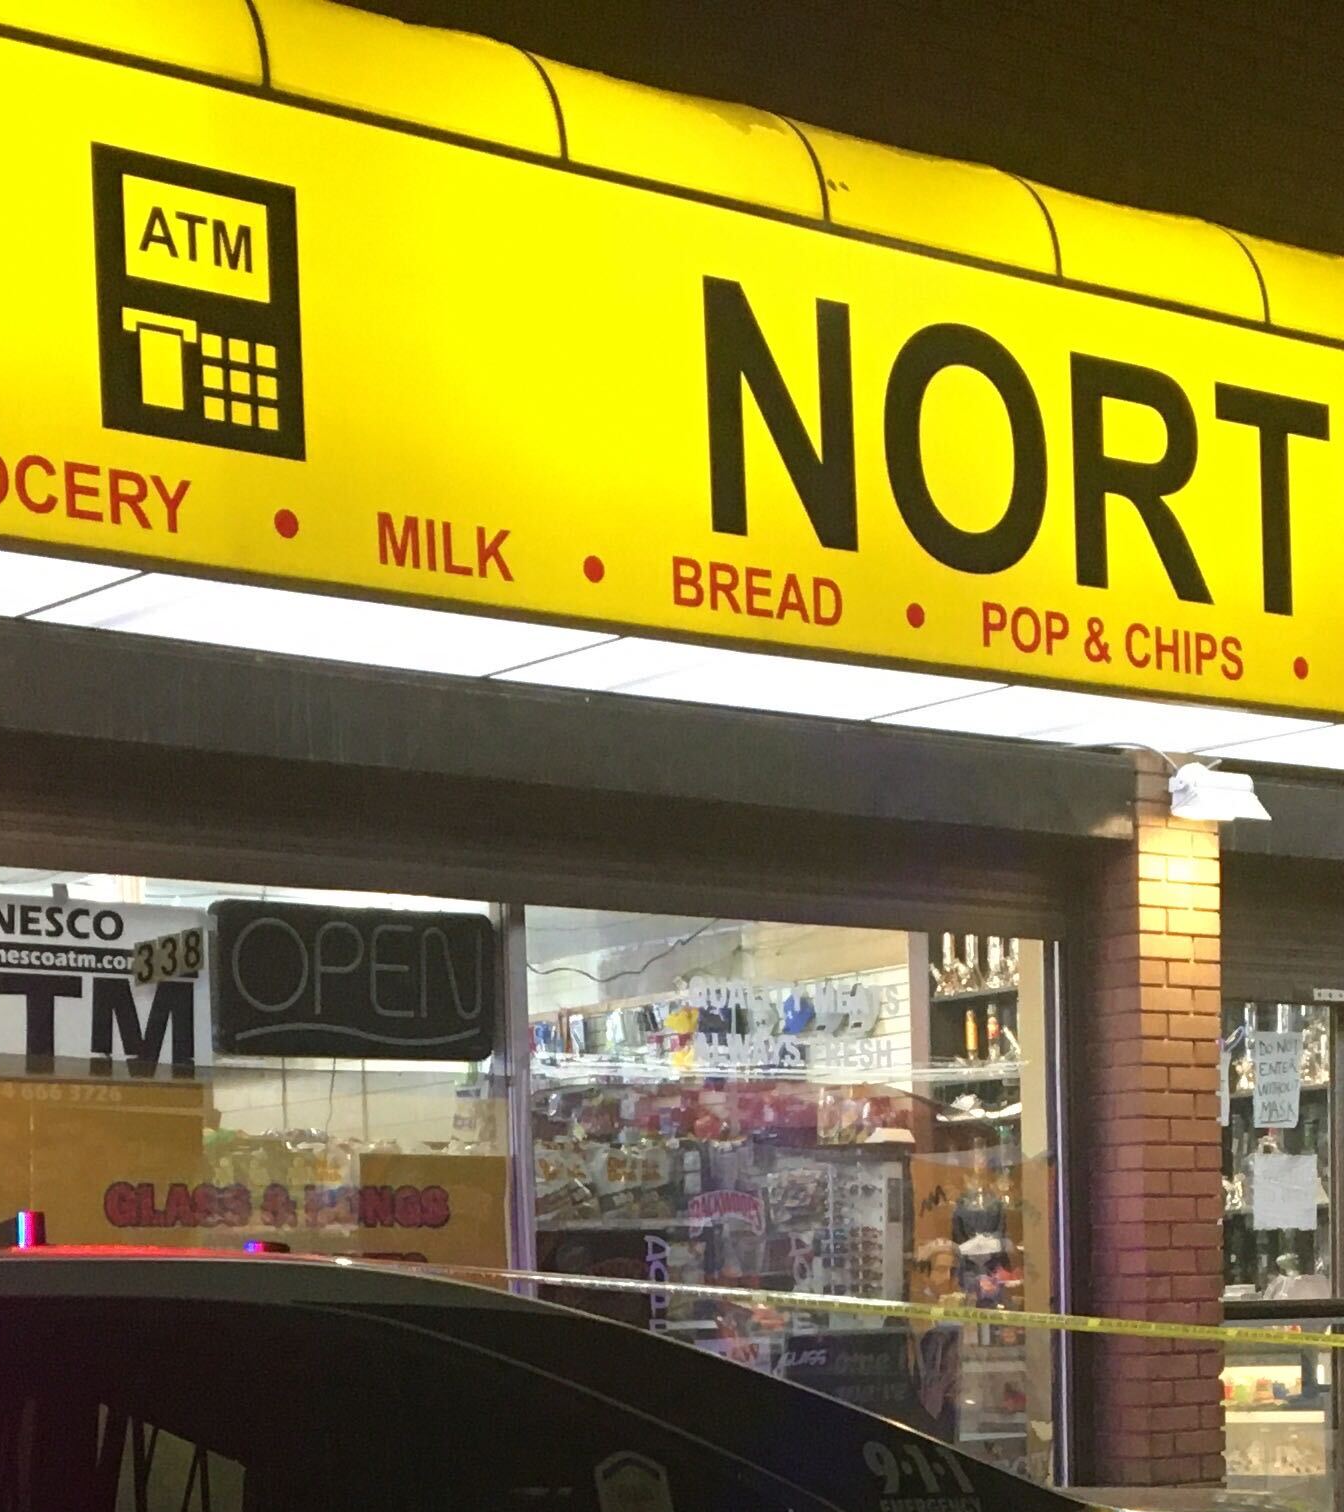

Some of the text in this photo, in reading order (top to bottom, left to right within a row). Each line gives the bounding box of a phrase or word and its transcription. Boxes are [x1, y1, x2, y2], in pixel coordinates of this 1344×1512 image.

[138, 206, 254, 273] ATM
[377, 511, 514, 582] MILK
[672, 556, 844, 628] BREAD
[981, 601, 1244, 682] POP & CHIPS
[137, 929, 201, 983] 338
[232, 916, 483, 1021] OPEN
[1258, 1059, 1298, 1078] ENTER
[104, 1181, 252, 1228] GLASS
